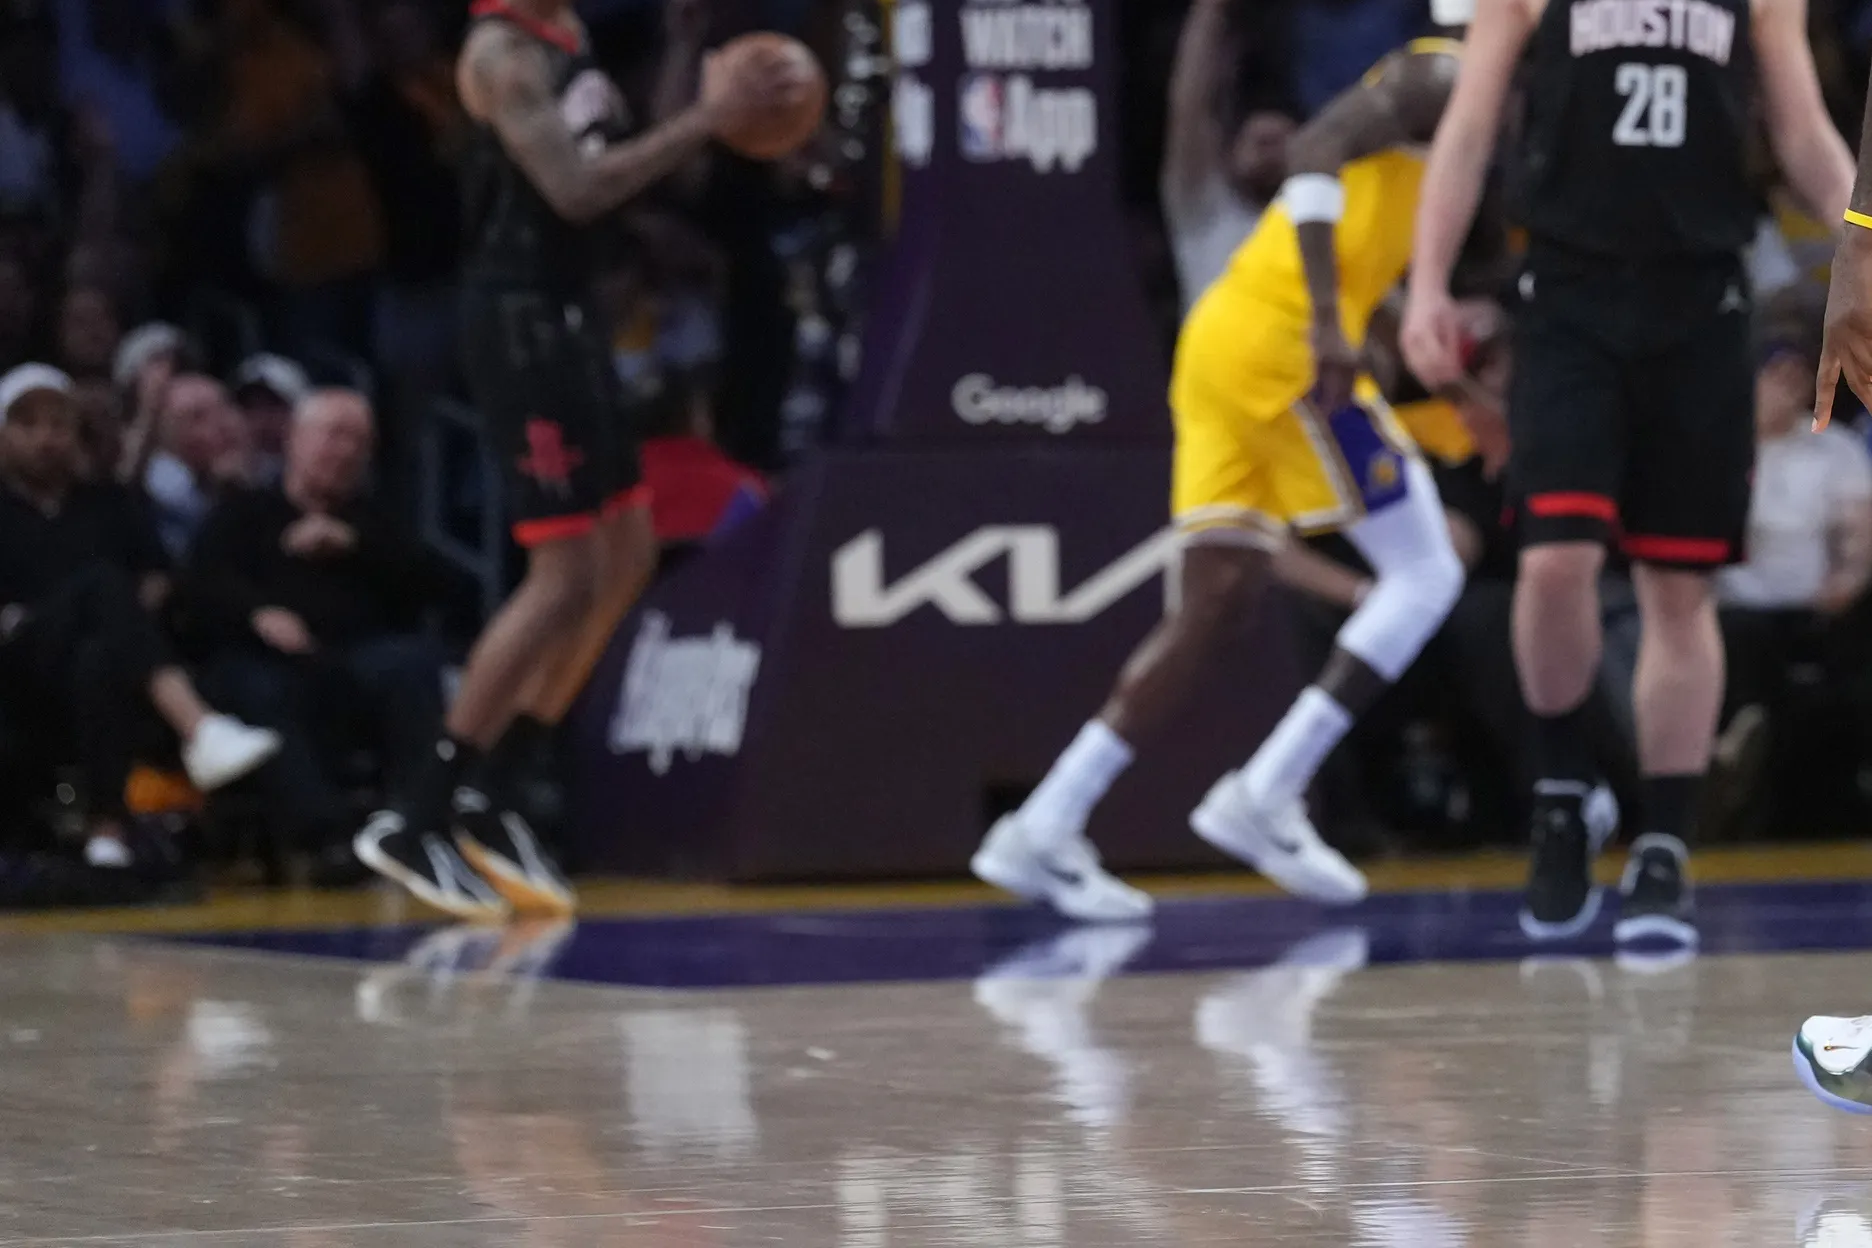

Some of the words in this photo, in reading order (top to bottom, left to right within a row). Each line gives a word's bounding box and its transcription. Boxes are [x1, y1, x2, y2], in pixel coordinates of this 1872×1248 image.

[959, 4, 1094, 70] WATCH
[1612, 62, 1688, 148] 28
[951, 372, 1108, 434] Google
